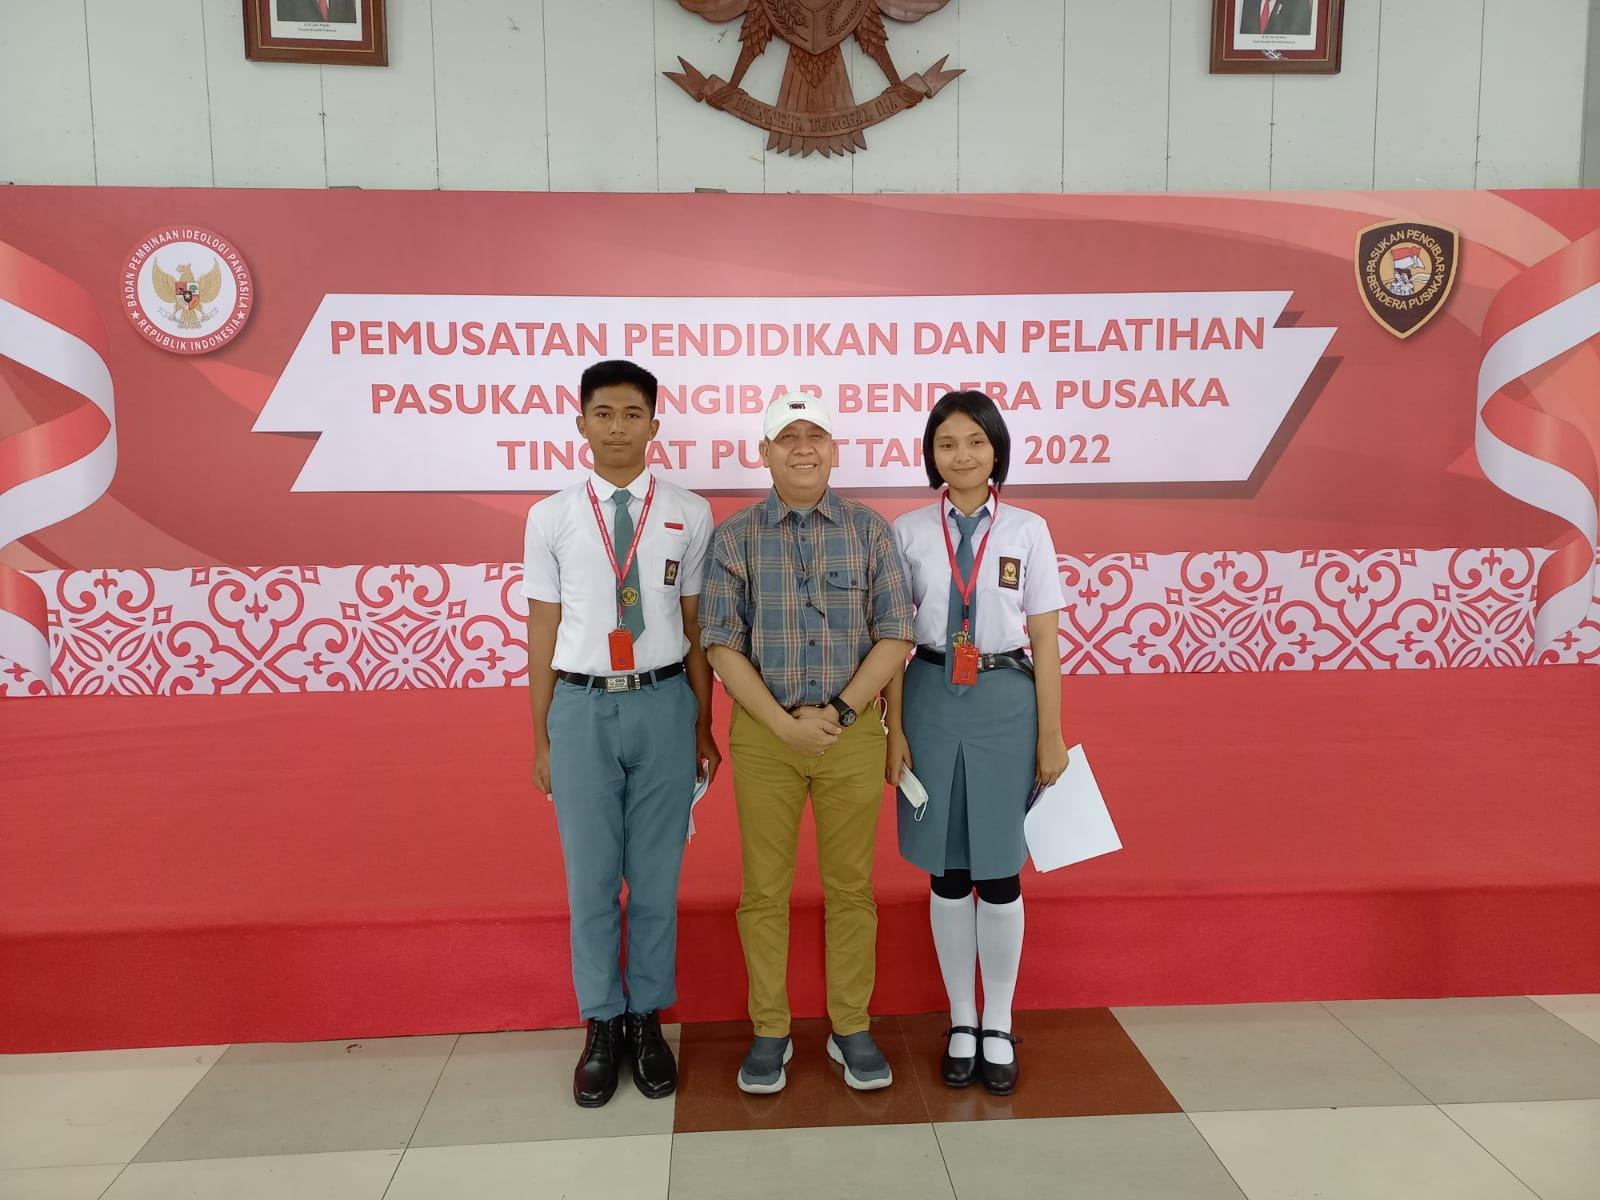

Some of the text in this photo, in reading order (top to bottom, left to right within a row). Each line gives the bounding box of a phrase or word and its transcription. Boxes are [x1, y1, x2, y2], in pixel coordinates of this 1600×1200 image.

[125, 229, 249, 308] BADAN PEMBINAAN IDEOLOGI PANCASILA
[1367, 229, 1445, 272] PASUKAN PENGIBAR
[1367, 274, 1445, 310] BENDERA PUSAKA
[138, 319, 241, 350] REPUBLIK INDONESIA
[331, 317, 1264, 357] PEMUSATAN PENDIDIKAN DAN PELATIHAN
[371, 384, 582, 414] PASUKAN
[1056, 378, 1229, 410] PUSAKA
[1026, 434, 1110, 464] 2022
